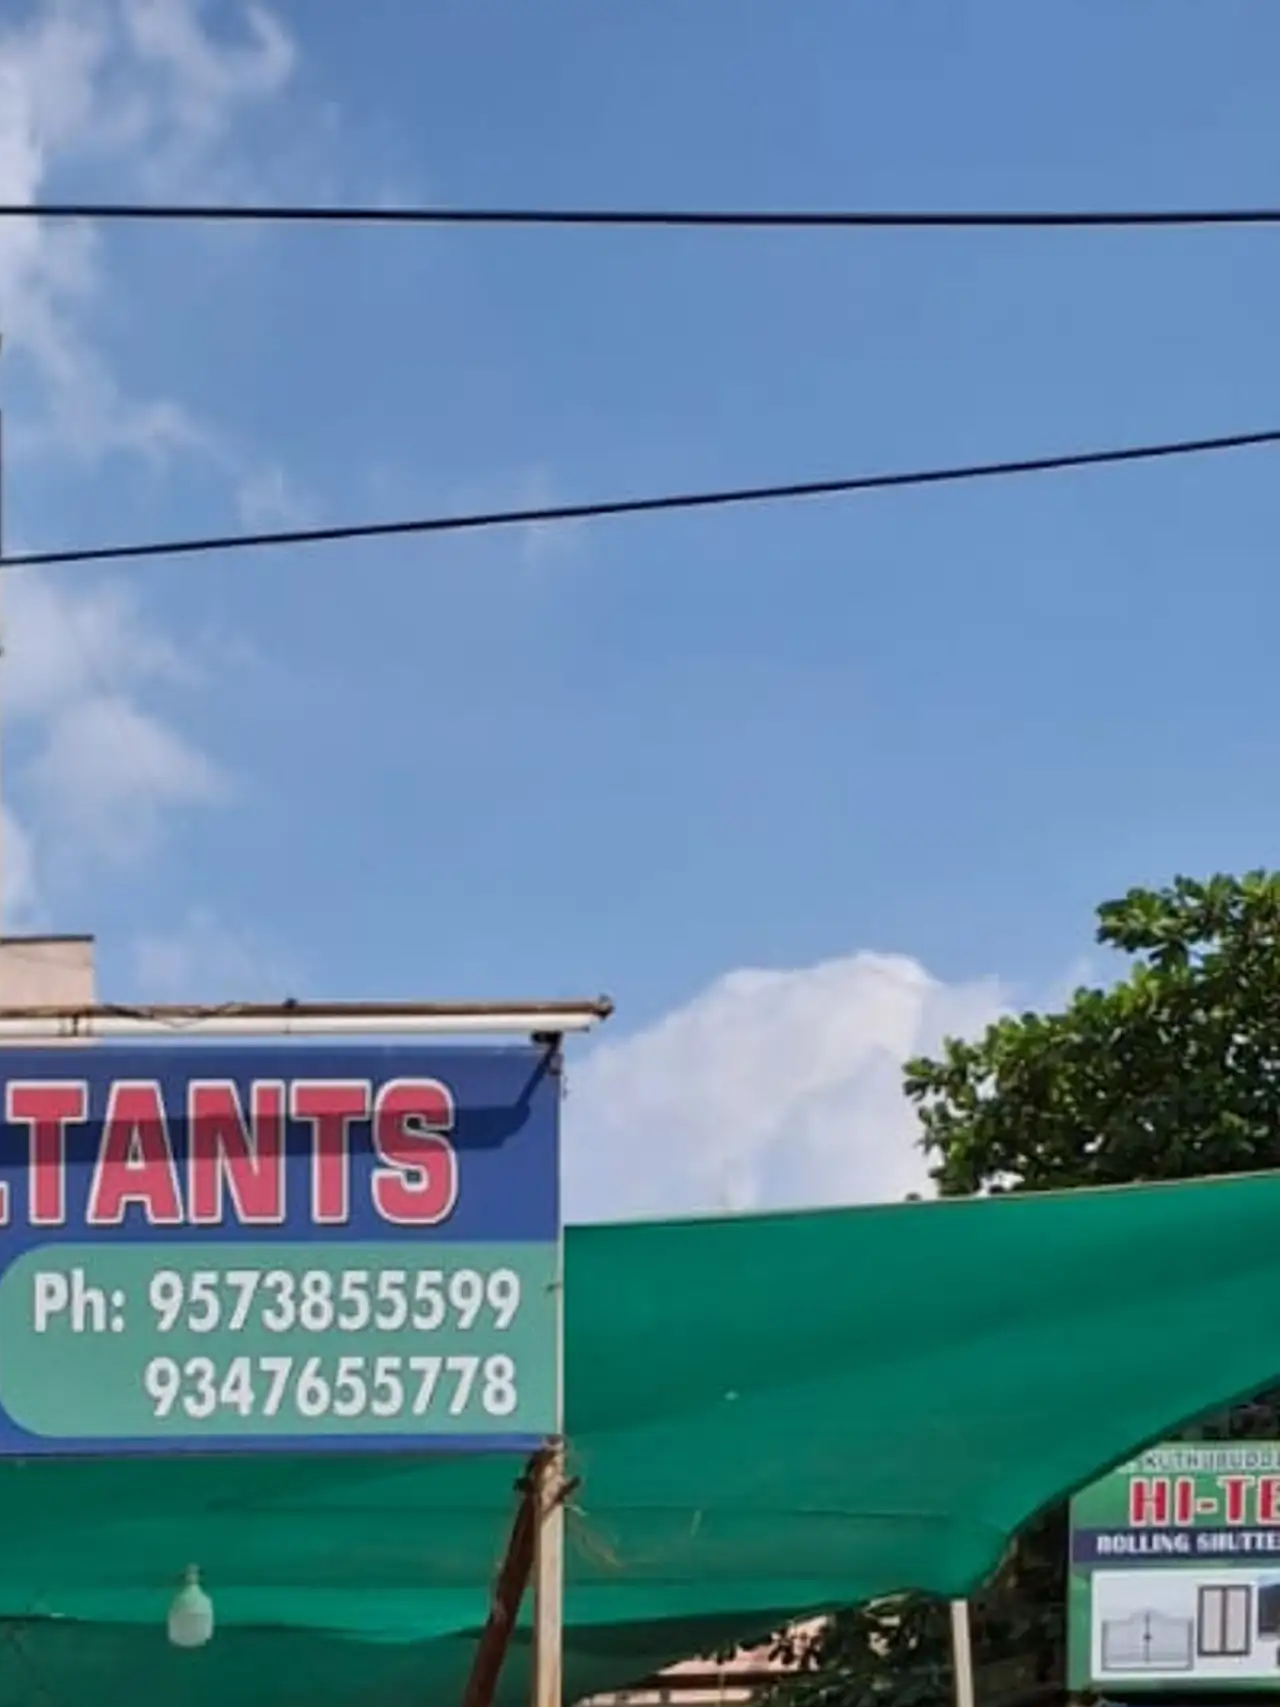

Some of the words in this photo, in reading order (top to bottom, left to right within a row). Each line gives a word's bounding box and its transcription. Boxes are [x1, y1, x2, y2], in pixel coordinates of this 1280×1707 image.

[33, 1268, 124, 1332] Ph:
[148, 1268, 521, 1333] 9573855599
[146, 1355, 517, 1417] 9347655778
[1096, 1534, 1190, 1554] ROLLING
